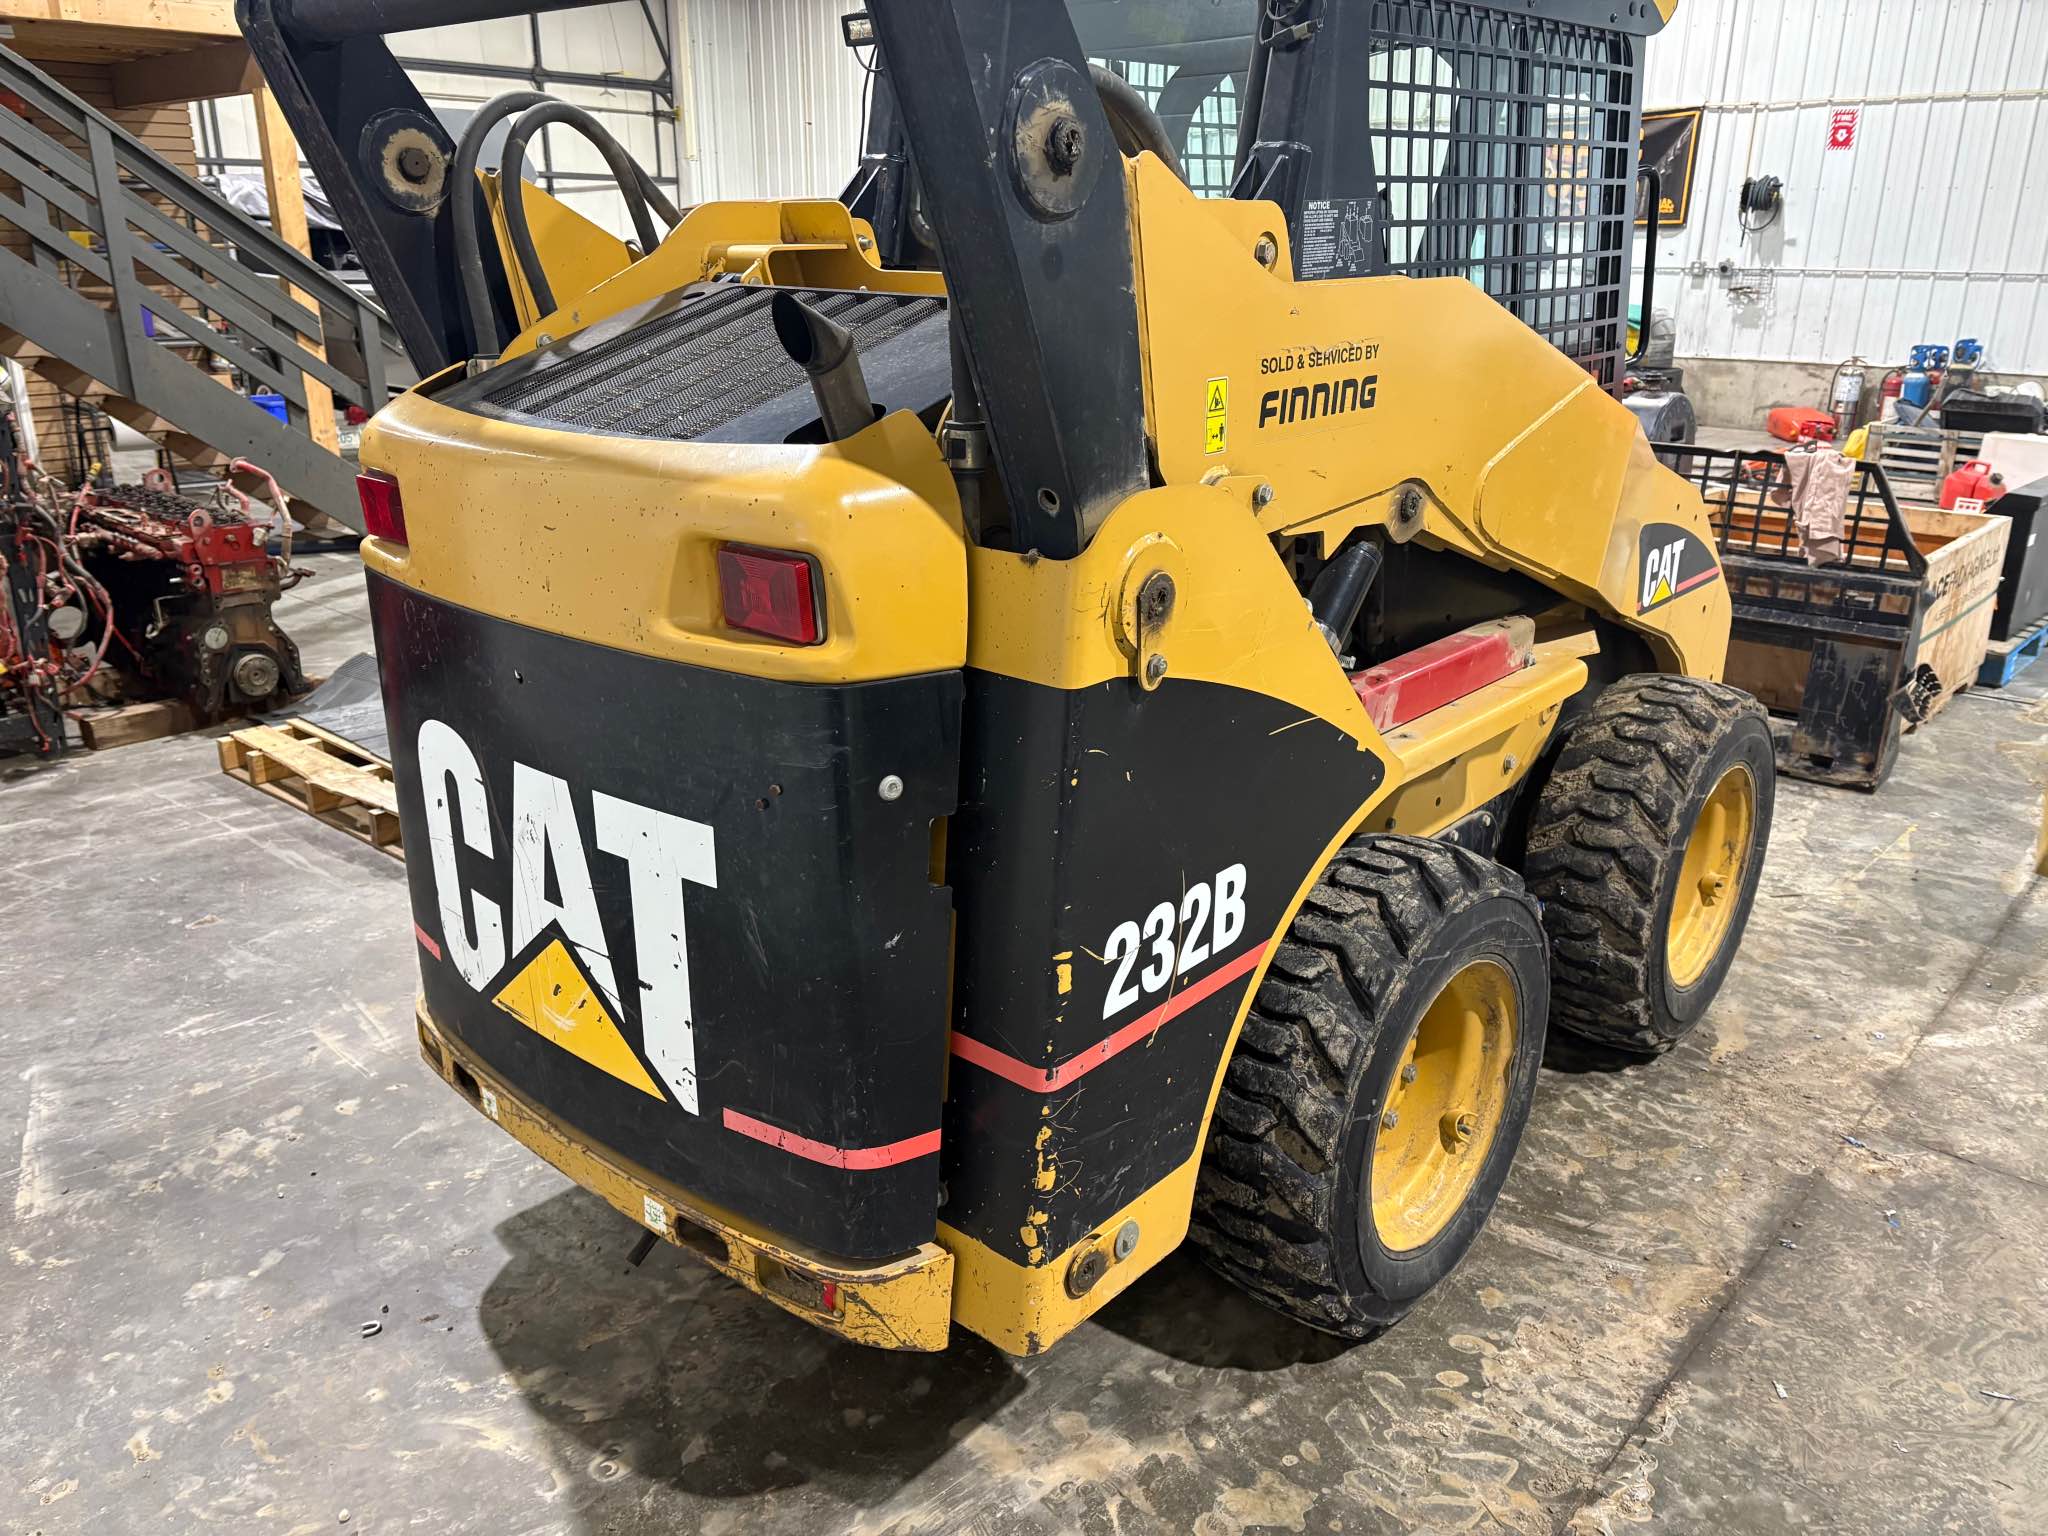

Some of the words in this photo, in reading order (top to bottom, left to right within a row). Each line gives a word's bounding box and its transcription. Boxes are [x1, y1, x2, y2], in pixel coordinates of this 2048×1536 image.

[1308, 200, 1331, 210] NOTICE
[1261, 355, 1294, 375] SOLD
[1297, 353, 1305, 369] &
[1365, 344, 1379, 359] BY
[1258, 375, 1378, 428] FINNING
[1642, 538, 1687, 608] CAT
[418, 719, 718, 1116] CAT
[1102, 863, 1247, 1021] 232B
